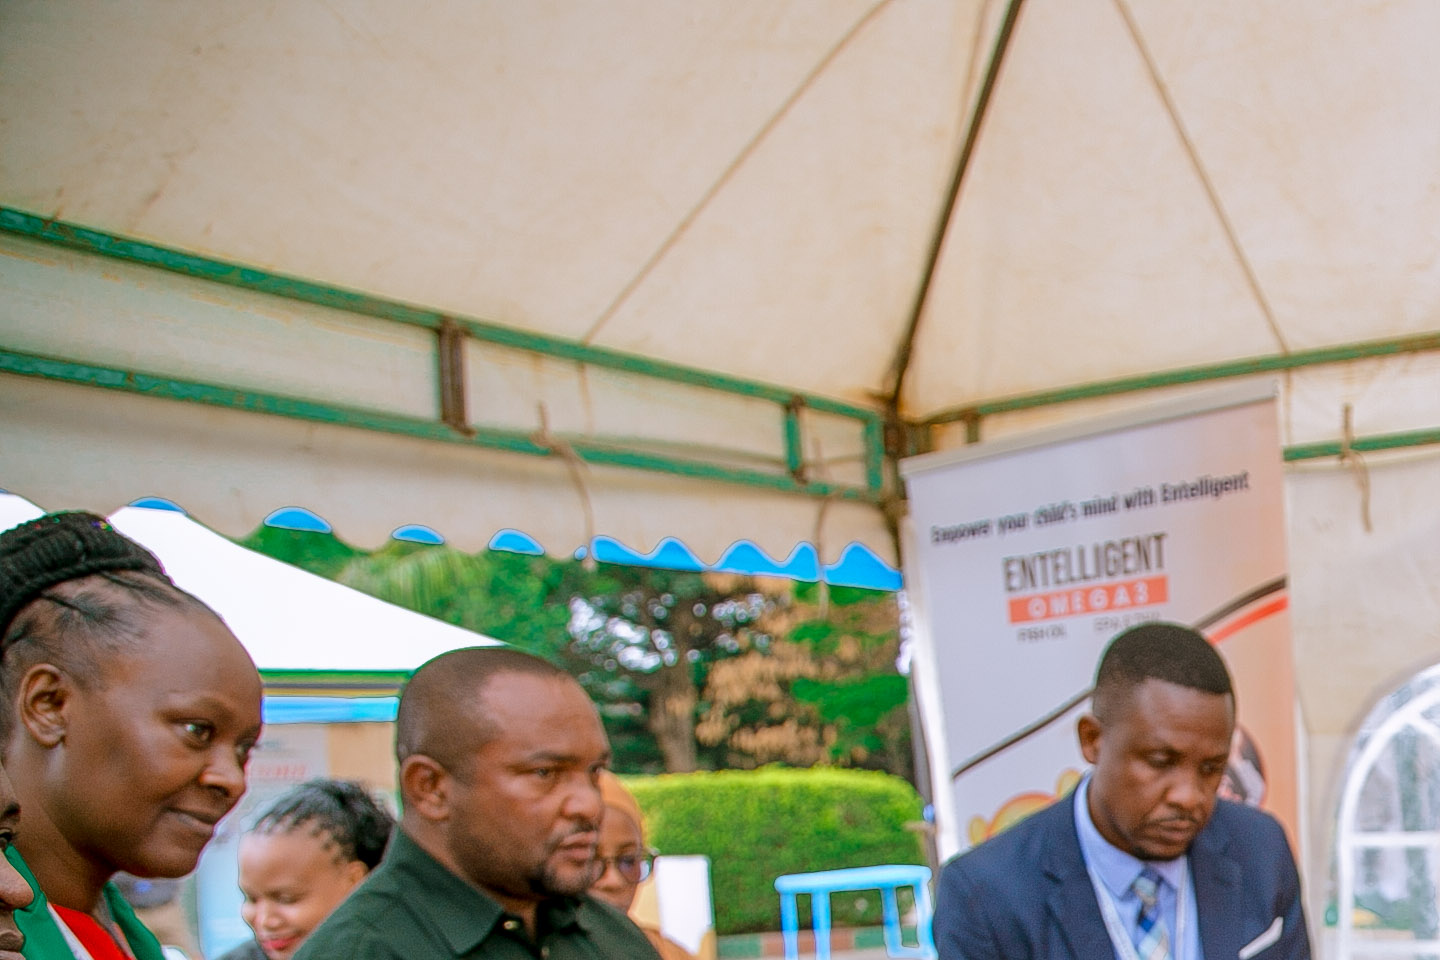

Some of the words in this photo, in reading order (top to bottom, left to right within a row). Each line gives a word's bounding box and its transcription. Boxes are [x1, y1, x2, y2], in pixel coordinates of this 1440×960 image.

[931, 519, 992, 546] Empower
[998, 512, 1030, 536] your
[1034, 500, 1077, 526] child's
[1081, 494, 1119, 518] mind
[1124, 484, 1154, 511] with
[1160, 471, 1249, 503] Entelligent
[1003, 532, 1168, 593] ENTELLIGENT
